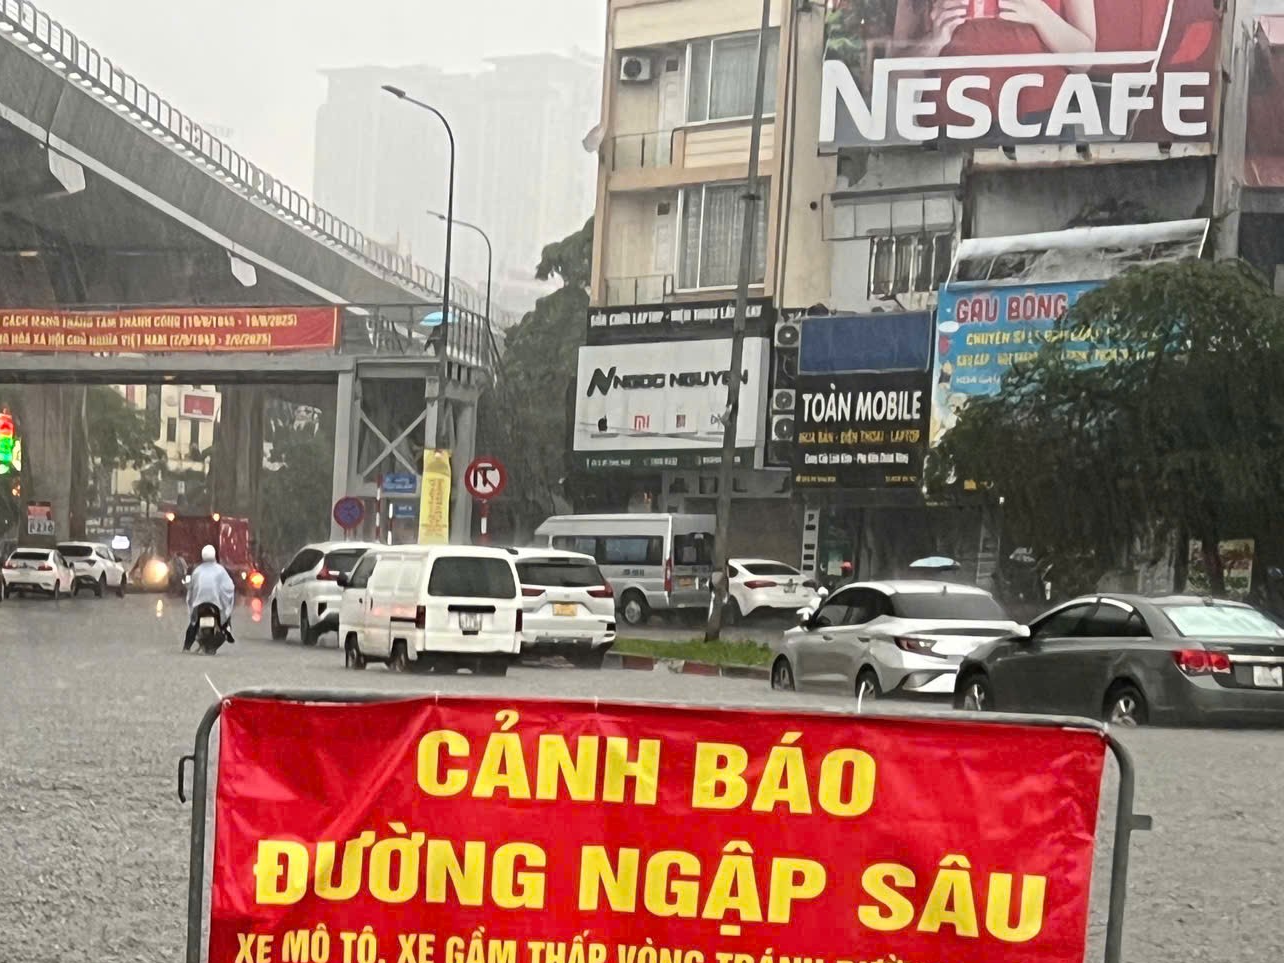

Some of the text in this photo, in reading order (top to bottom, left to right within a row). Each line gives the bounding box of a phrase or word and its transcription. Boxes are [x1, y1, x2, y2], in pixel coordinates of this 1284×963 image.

[802, 383, 922, 423] TOÀN MOBILE
[417, 709, 877, 817] CẢNH BÁO
[252, 822, 1047, 943] ĐƯỜNG NGẬP SÂU
